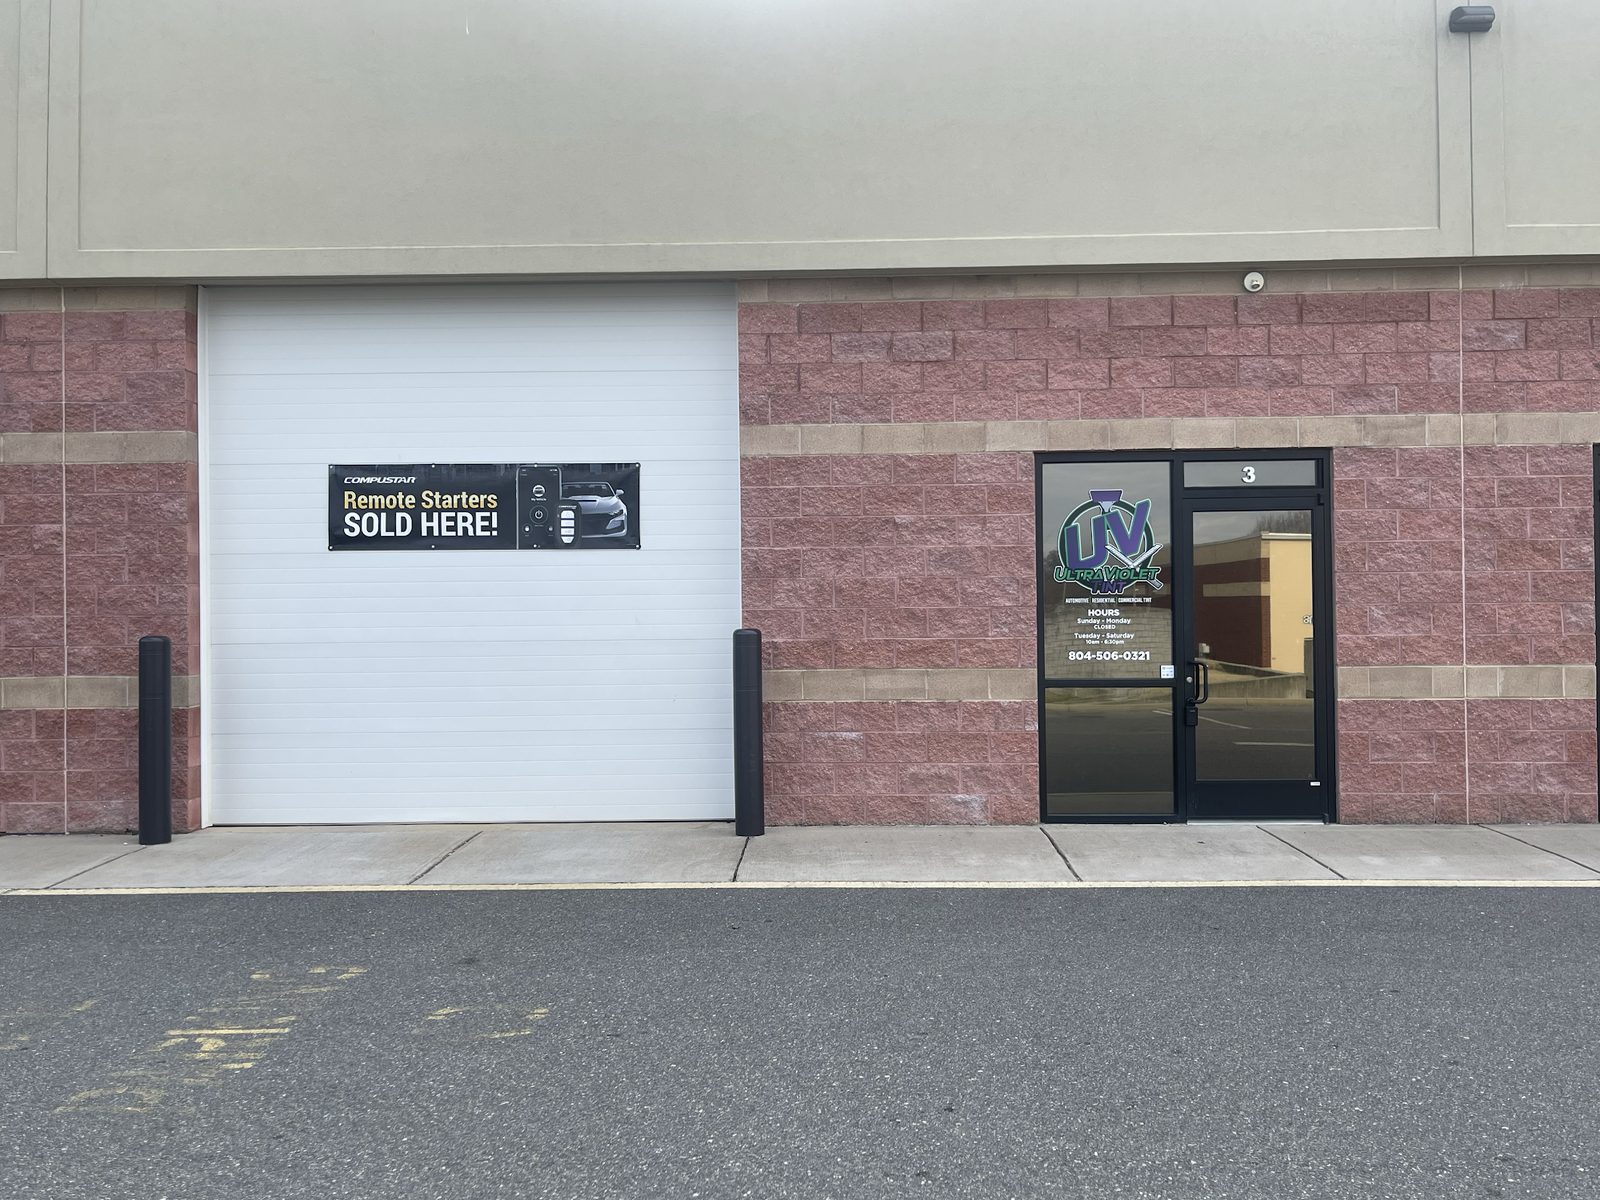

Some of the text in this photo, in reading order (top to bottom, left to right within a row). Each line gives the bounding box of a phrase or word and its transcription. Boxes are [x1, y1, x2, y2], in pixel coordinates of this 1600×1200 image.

[343, 476, 416, 484] COMPUSTAR
[1242, 466, 1256, 483] 3
[344, 489, 498, 510] Remote Starters
[343, 512, 498, 537] SOLD HERE!
[1064, 499, 1151, 569] UV
[1087, 609, 1120, 617] HOURS
[1068, 651, 1150, 660] 804-506-0321
